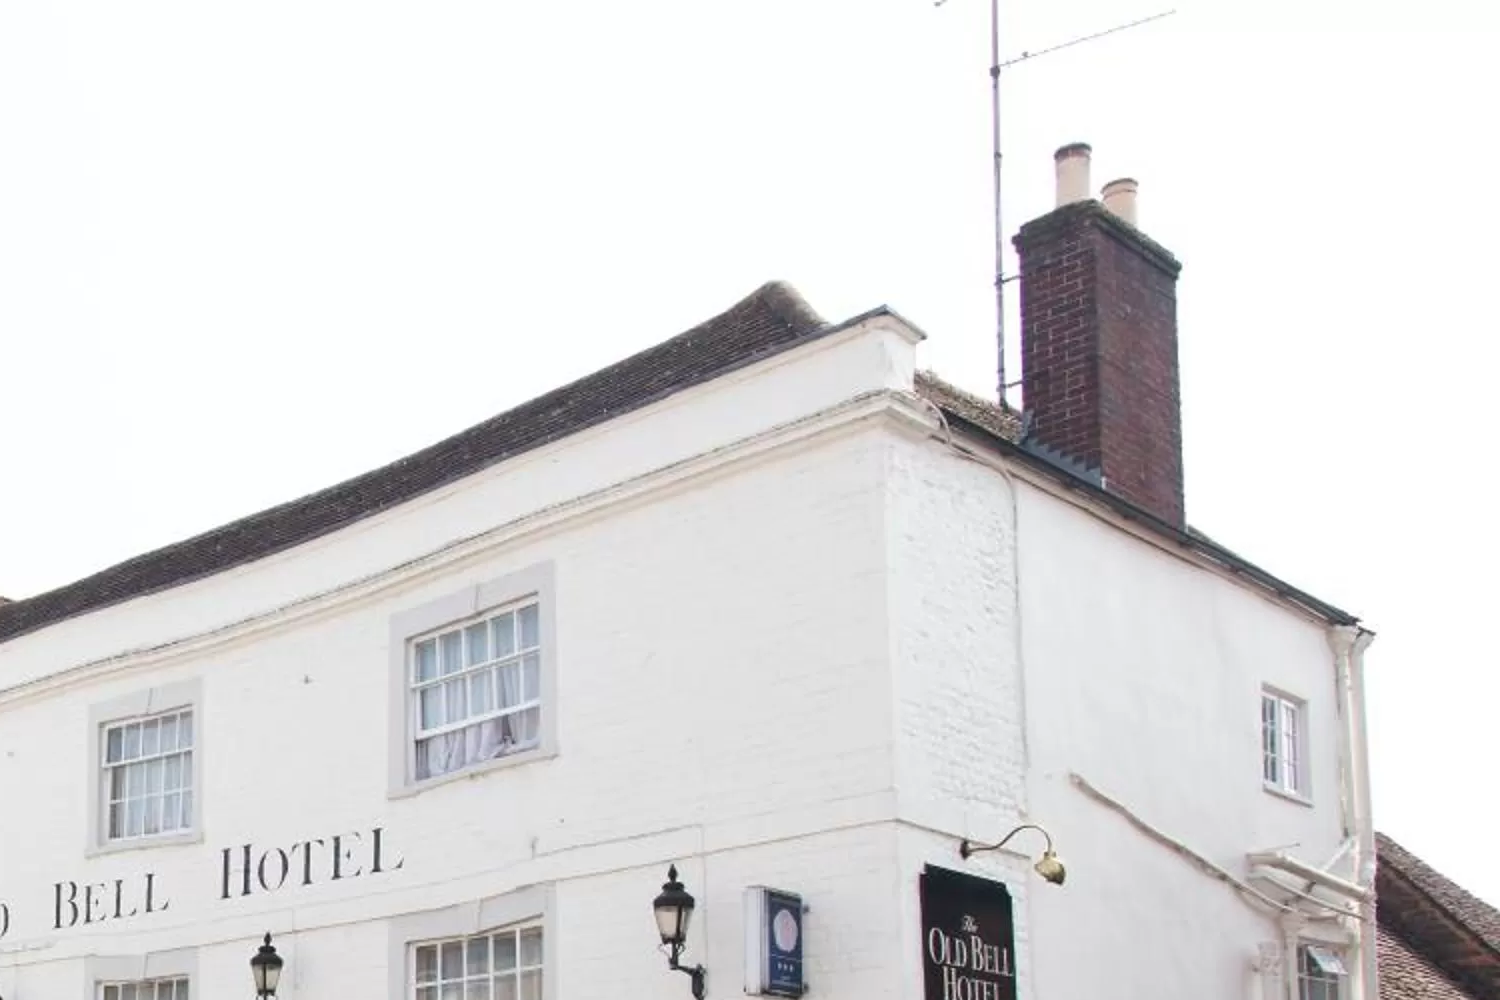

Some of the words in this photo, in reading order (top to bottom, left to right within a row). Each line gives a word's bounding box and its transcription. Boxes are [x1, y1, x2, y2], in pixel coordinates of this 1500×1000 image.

[53, 873, 170, 930] BELL
[220, 827, 404, 900] HOTEL
[928, 927, 967, 967] OLD
[971, 935, 1014, 977] BELL
